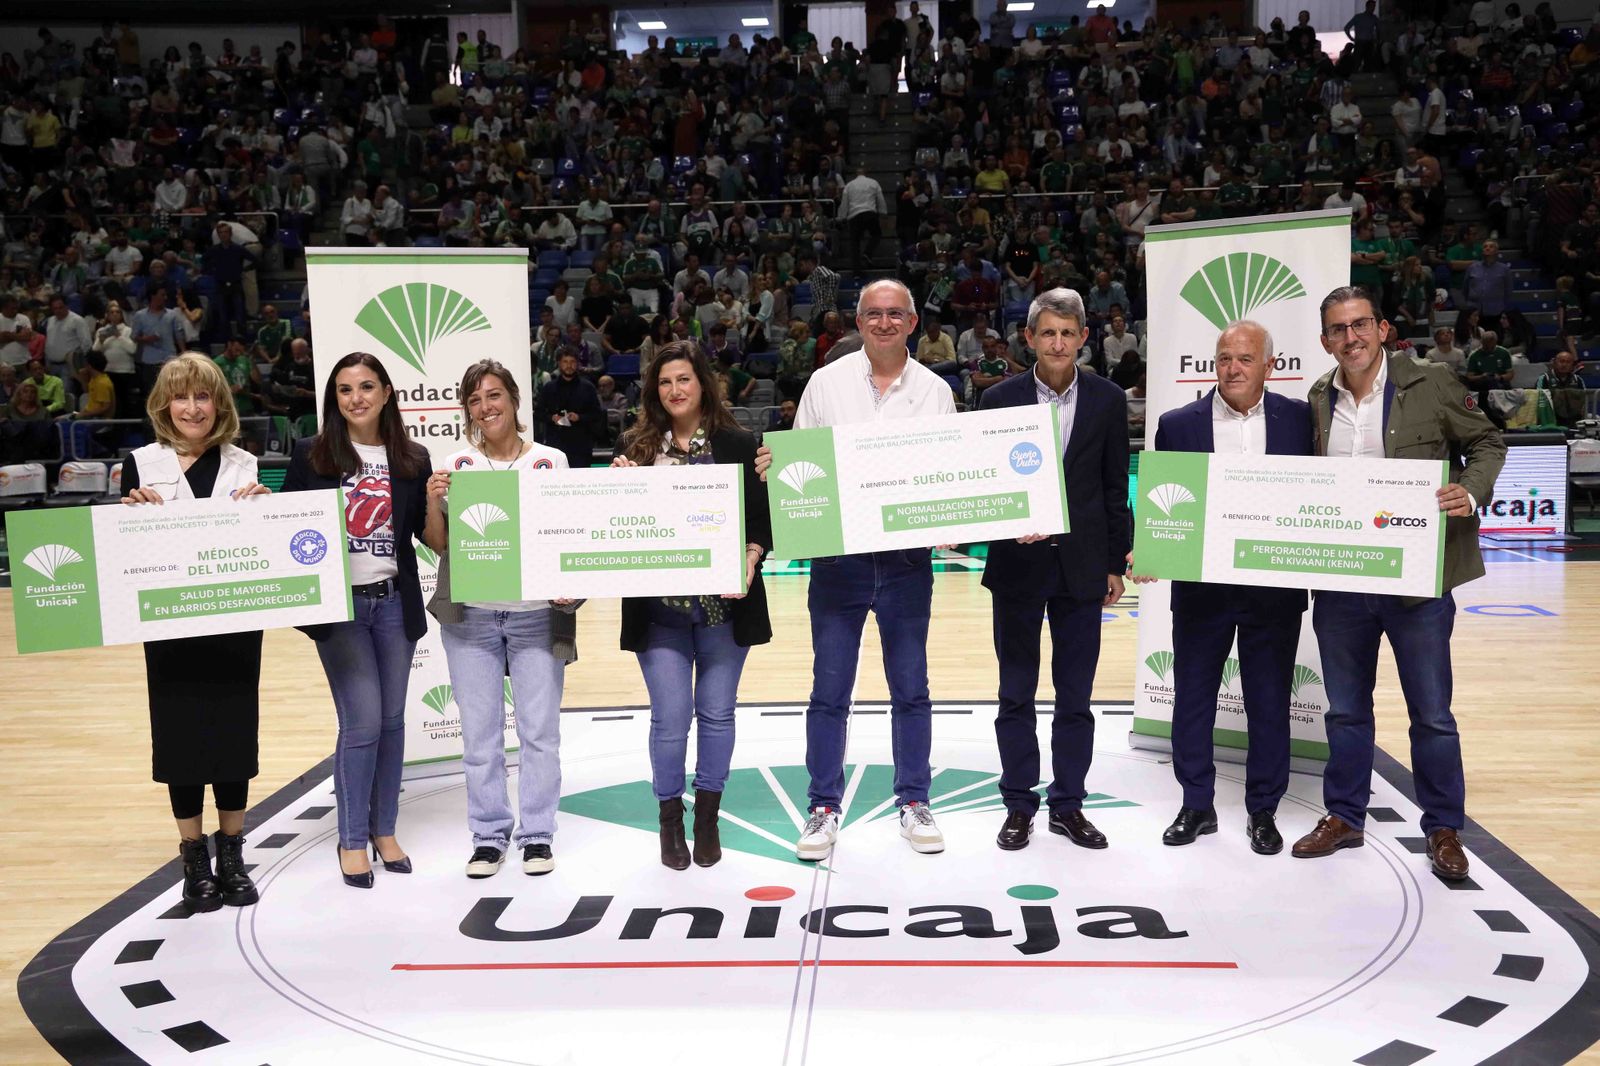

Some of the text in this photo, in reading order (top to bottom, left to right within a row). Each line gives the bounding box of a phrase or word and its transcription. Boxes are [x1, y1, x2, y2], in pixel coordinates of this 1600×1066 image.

[395, 382, 460, 402] ndaci
[405, 414, 467, 441] nicaj
[887, 438, 932, 447] BALONCESTO
[913, 472, 954, 485] SUEÑO
[959, 468, 997, 481] DULCE
[780, 496, 828, 507] Fundación
[897, 500, 974, 516] NORMALIZACIÓN
[978, 498, 989, 508] DE
[992, 497, 1014, 505] VIDA
[788, 508, 823, 519] Unicaja
[907, 514, 928, 524] CON
[931, 510, 973, 522] DIABETES
[976, 508, 996, 517] TIPO
[1298, 505, 1341, 516] ARCOS
[119, 526, 153, 534] UNICAJA
[155, 521, 208, 530] BALONCESTO
[215, 518, 240, 527] BARÇA
[610, 516, 656, 526] CIUDAD
[1146, 518, 1194, 528] Fundación
[1276, 517, 1363, 530] SOLIDARIDAD
[1390, 517, 1427, 528] arcos
[591, 530, 606, 540] DE
[610, 529, 632, 539] LOS
[636, 526, 675, 538] NIÑOS
[1152, 531, 1185, 541] Unicaja
[461, 539, 509, 548] Fundación
[198, 546, 258, 561] MÉDICOS
[292, 550, 301, 561] DEL
[304, 550, 324, 563] MUNDO
[468, 552, 502, 561] Unicaja
[1253, 545, 1319, 556] PERFORACIÓN
[1323, 549, 1335, 558] DE
[1338, 550, 1353, 558] UN
[1356, 551, 1384, 560] POZO
[575, 557, 628, 566] ECOCIUDAD
[646, 555, 662, 563] LOS
[665, 554, 695, 563] NIÑOS
[1271, 556, 1364, 570] EN KIVAANI (KENIA)
[130, 565, 166, 574] BENEFICIO
[188, 565, 213, 576] DEL
[217, 560, 270, 573] MUNDO
[26, 582, 85, 594] Fundación
[180, 589, 214, 600] SALUD
[217, 588, 230, 596] DE
[233, 584, 281, 595] MAYORES
[36, 596, 77, 607] Unicaja
[143, 593, 307, 616] # EN BARRIOS DESFAVORECIDOS
[1144, 683, 1175, 693] Fundac
[1150, 696, 1175, 707] Unicaj
[1219, 692, 1244, 701] ndaci
[1290, 701, 1321, 710] dación
[1290, 712, 1314, 724] nicaja
[430, 729, 462, 740] Unicaja
[458, 884, 1188, 954] Unicaja
